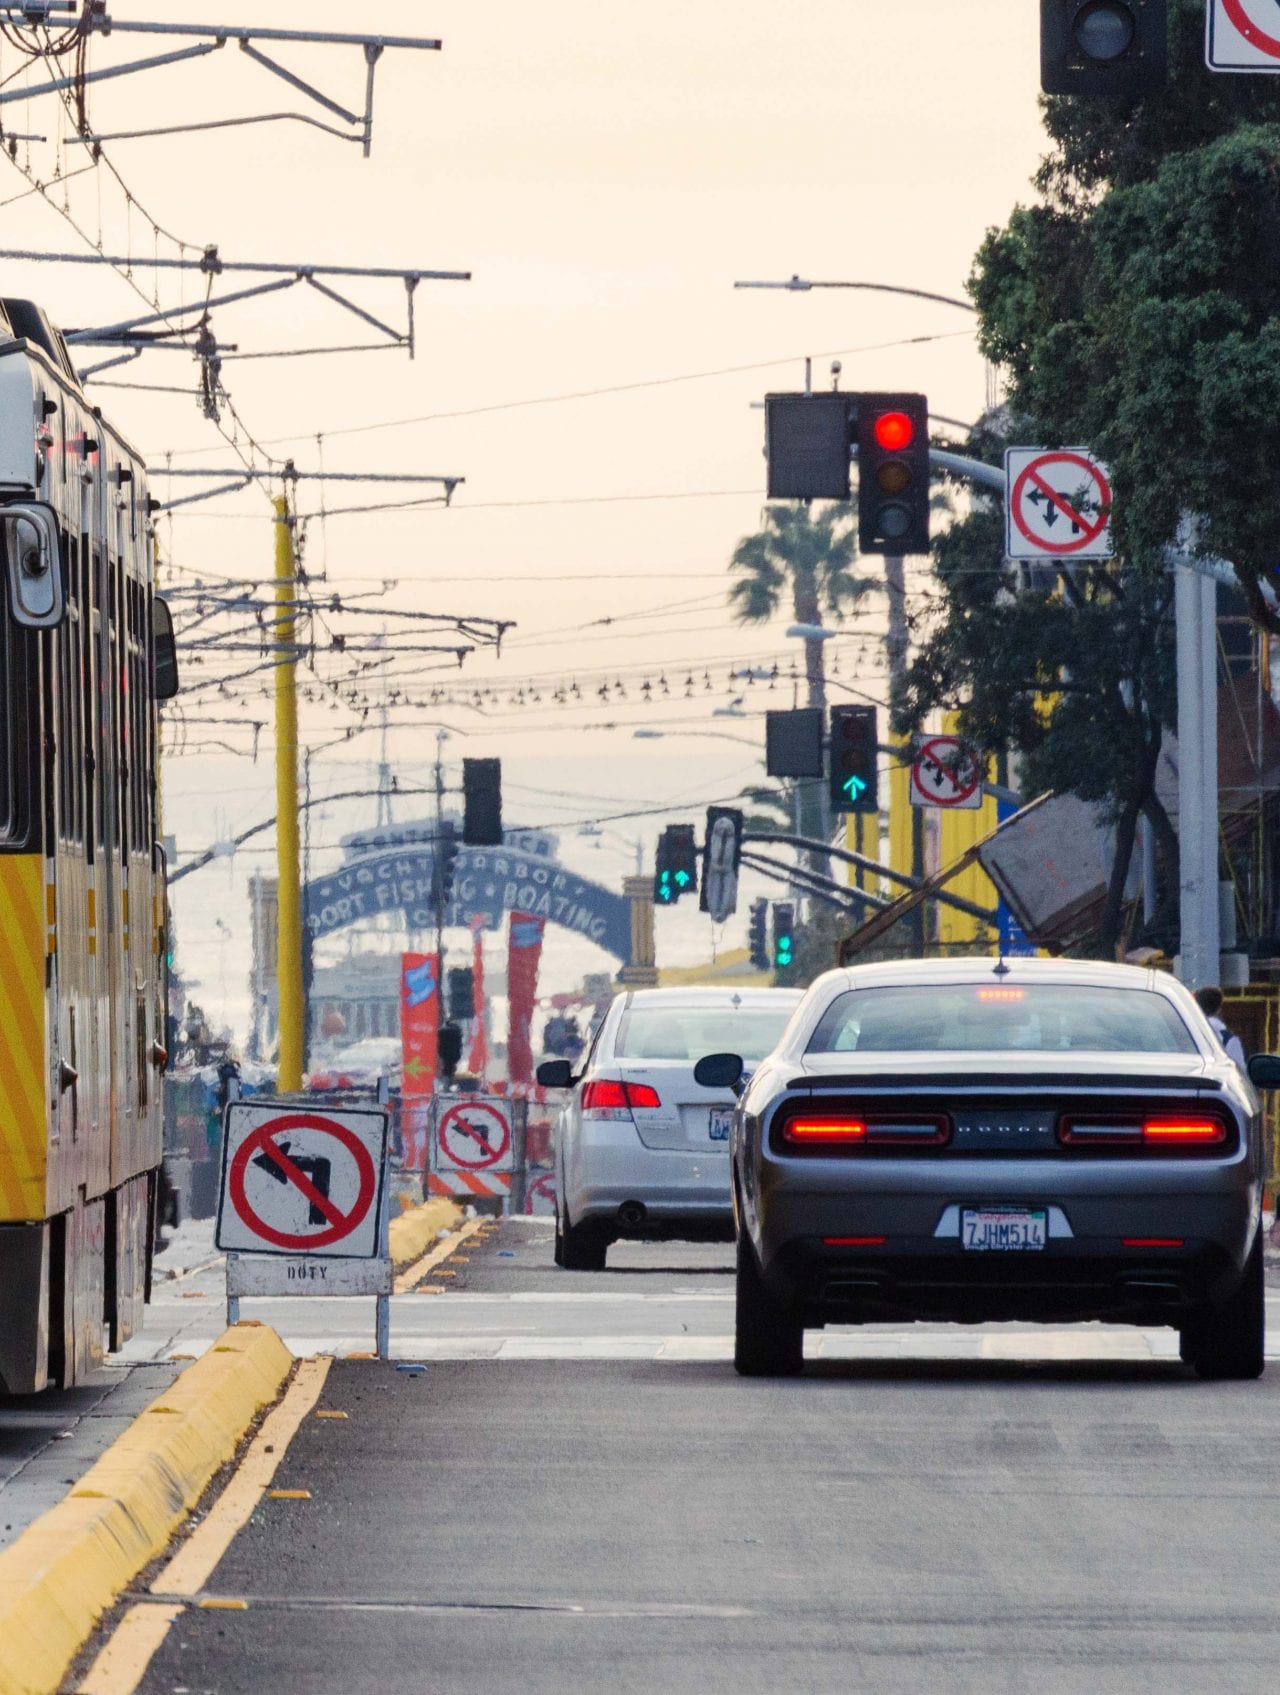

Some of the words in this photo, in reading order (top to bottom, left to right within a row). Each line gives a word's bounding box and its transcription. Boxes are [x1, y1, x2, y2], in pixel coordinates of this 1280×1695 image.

[307, 892, 365, 936] PORT
[504, 882, 607, 938] BOATING
[966, 1223, 1041, 1246] 7JHM514
